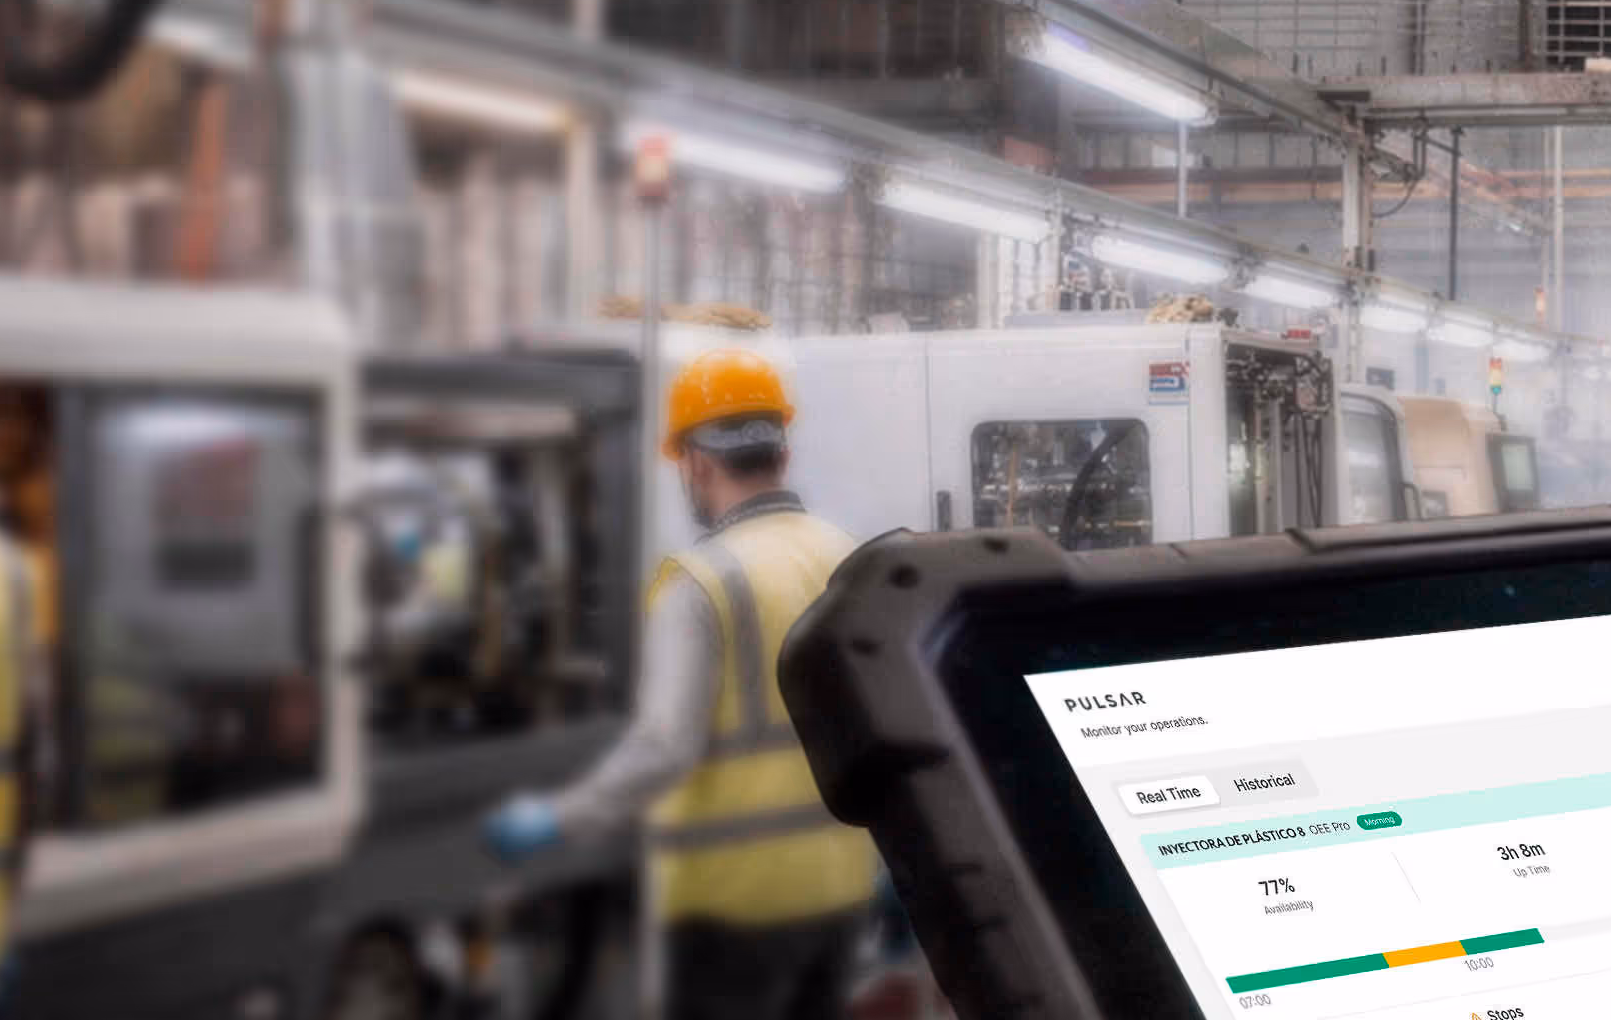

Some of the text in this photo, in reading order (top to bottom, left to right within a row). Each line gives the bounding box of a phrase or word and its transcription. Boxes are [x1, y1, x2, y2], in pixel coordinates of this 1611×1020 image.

[1064, 691, 1146, 712] PULSAR
[1082, 714, 1208, 738] Monitor your operations.
[1234, 773, 1295, 792] Historical
[1137, 785, 1201, 805] Real Time
[1364, 815, 1395, 828] Morning
[1158, 820, 1350, 856] INYECTORA DE PLÁSTICO 8 OEE Pro
[1497, 842, 1546, 862] 3h 8m
[1513, 864, 1550, 879] Up Time
[1258, 877, 1295, 896] 77%
[1263, 899, 1314, 916] Availability
[1464, 956, 1494, 972] 10:00
[1239, 994, 1272, 1010] 07:00
[1487, 1006, 1524, 1020] Stops
